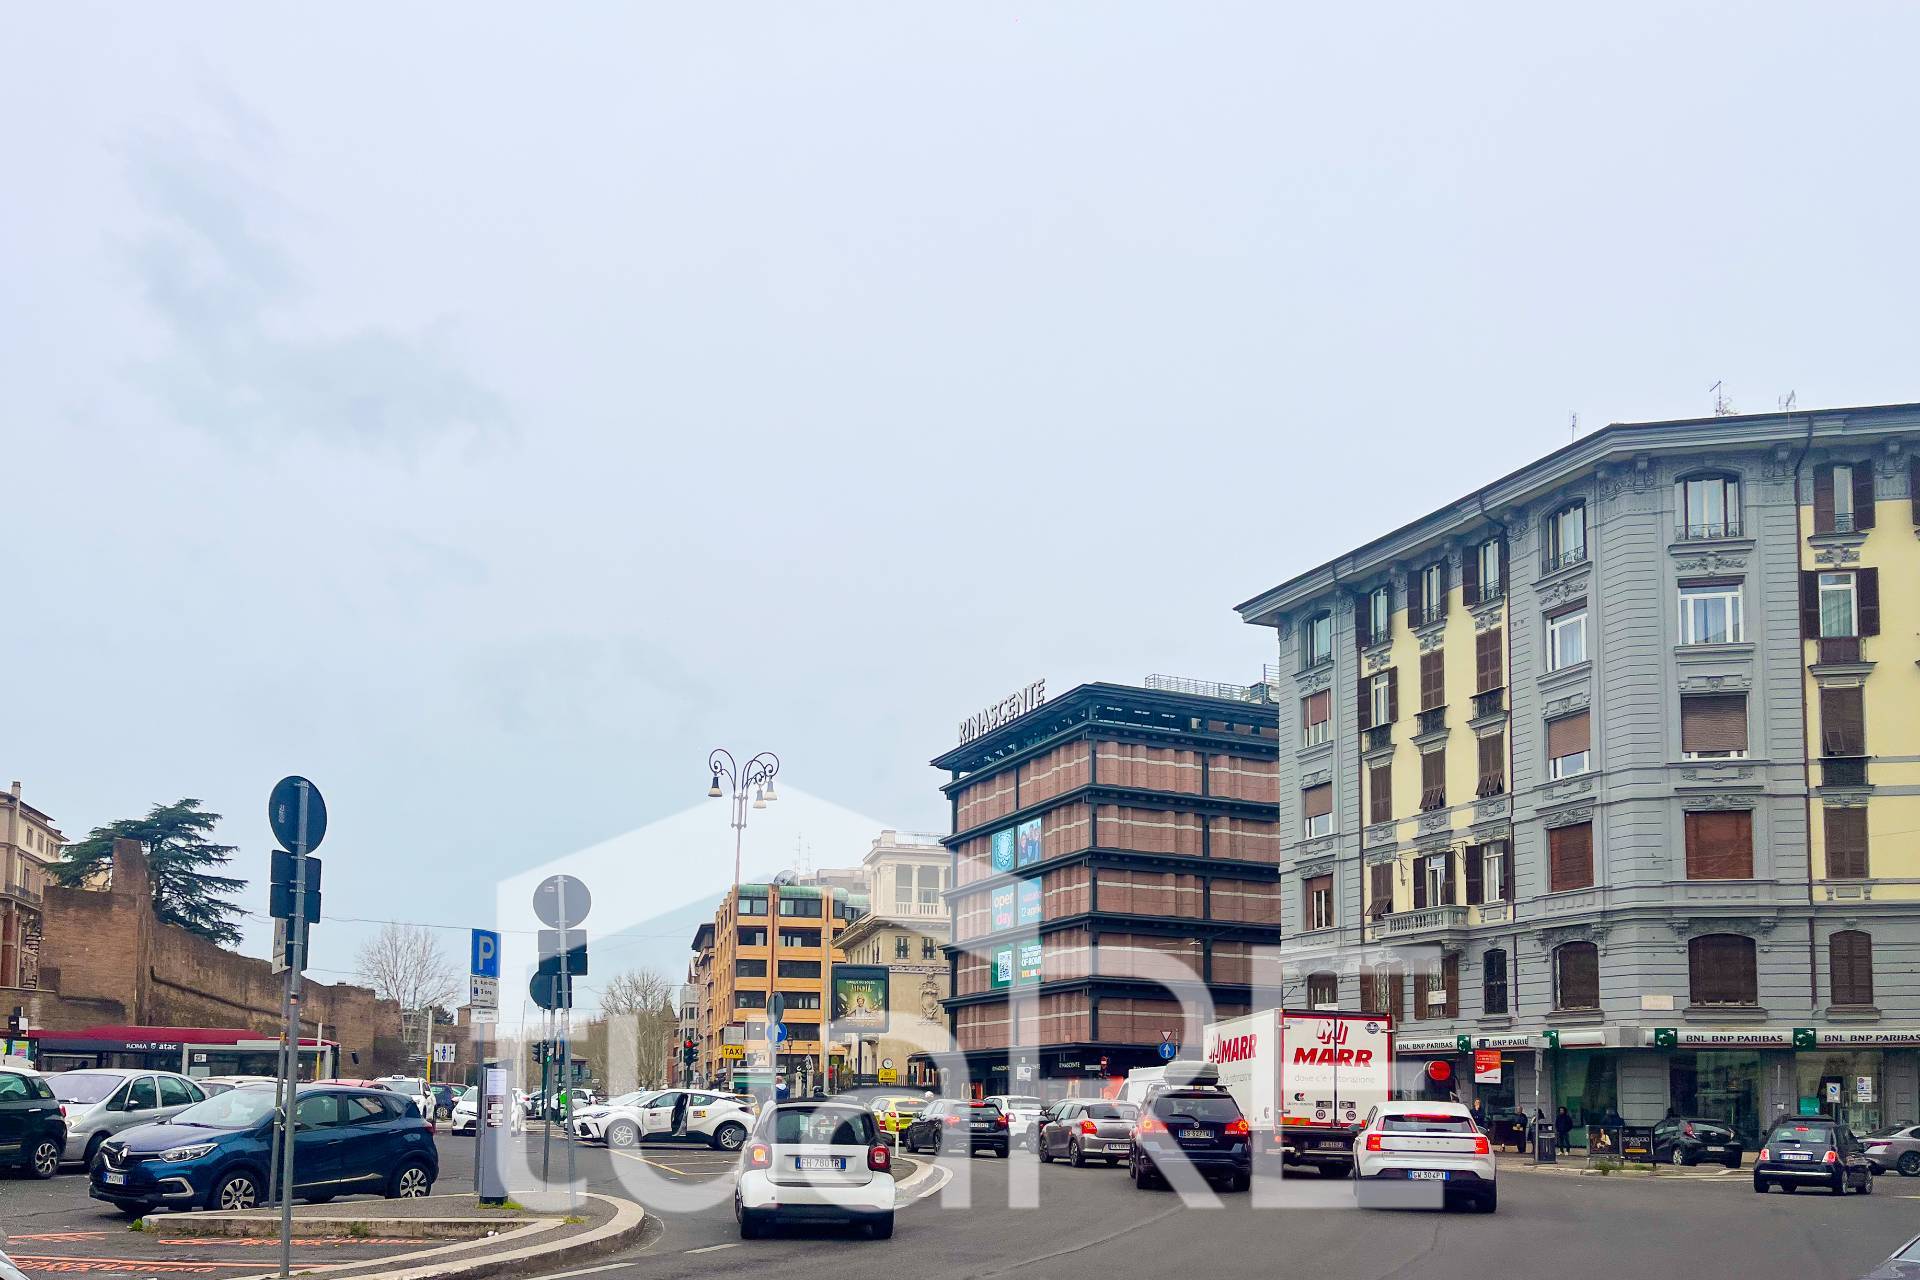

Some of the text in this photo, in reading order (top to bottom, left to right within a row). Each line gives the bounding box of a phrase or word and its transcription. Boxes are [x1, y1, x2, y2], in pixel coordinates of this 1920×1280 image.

[958, 678, 1046, 744] RINASCENTE
[479, 936, 495, 970] P
[1492, 1039, 1507, 1047] BNP
[1685, 1035, 1783, 1043] BNL BNP PARIBAS
[1824, 1034, 1846, 1042] BNL
[1850, 1034, 1873, 1042] BNP
[1221, 1034, 1258, 1063] MARR
[1412, 1042, 1425, 1050] BNP
[1426, 1041, 1453, 1049] PARIBAS
[1292, 1047, 1373, 1067] MARR
